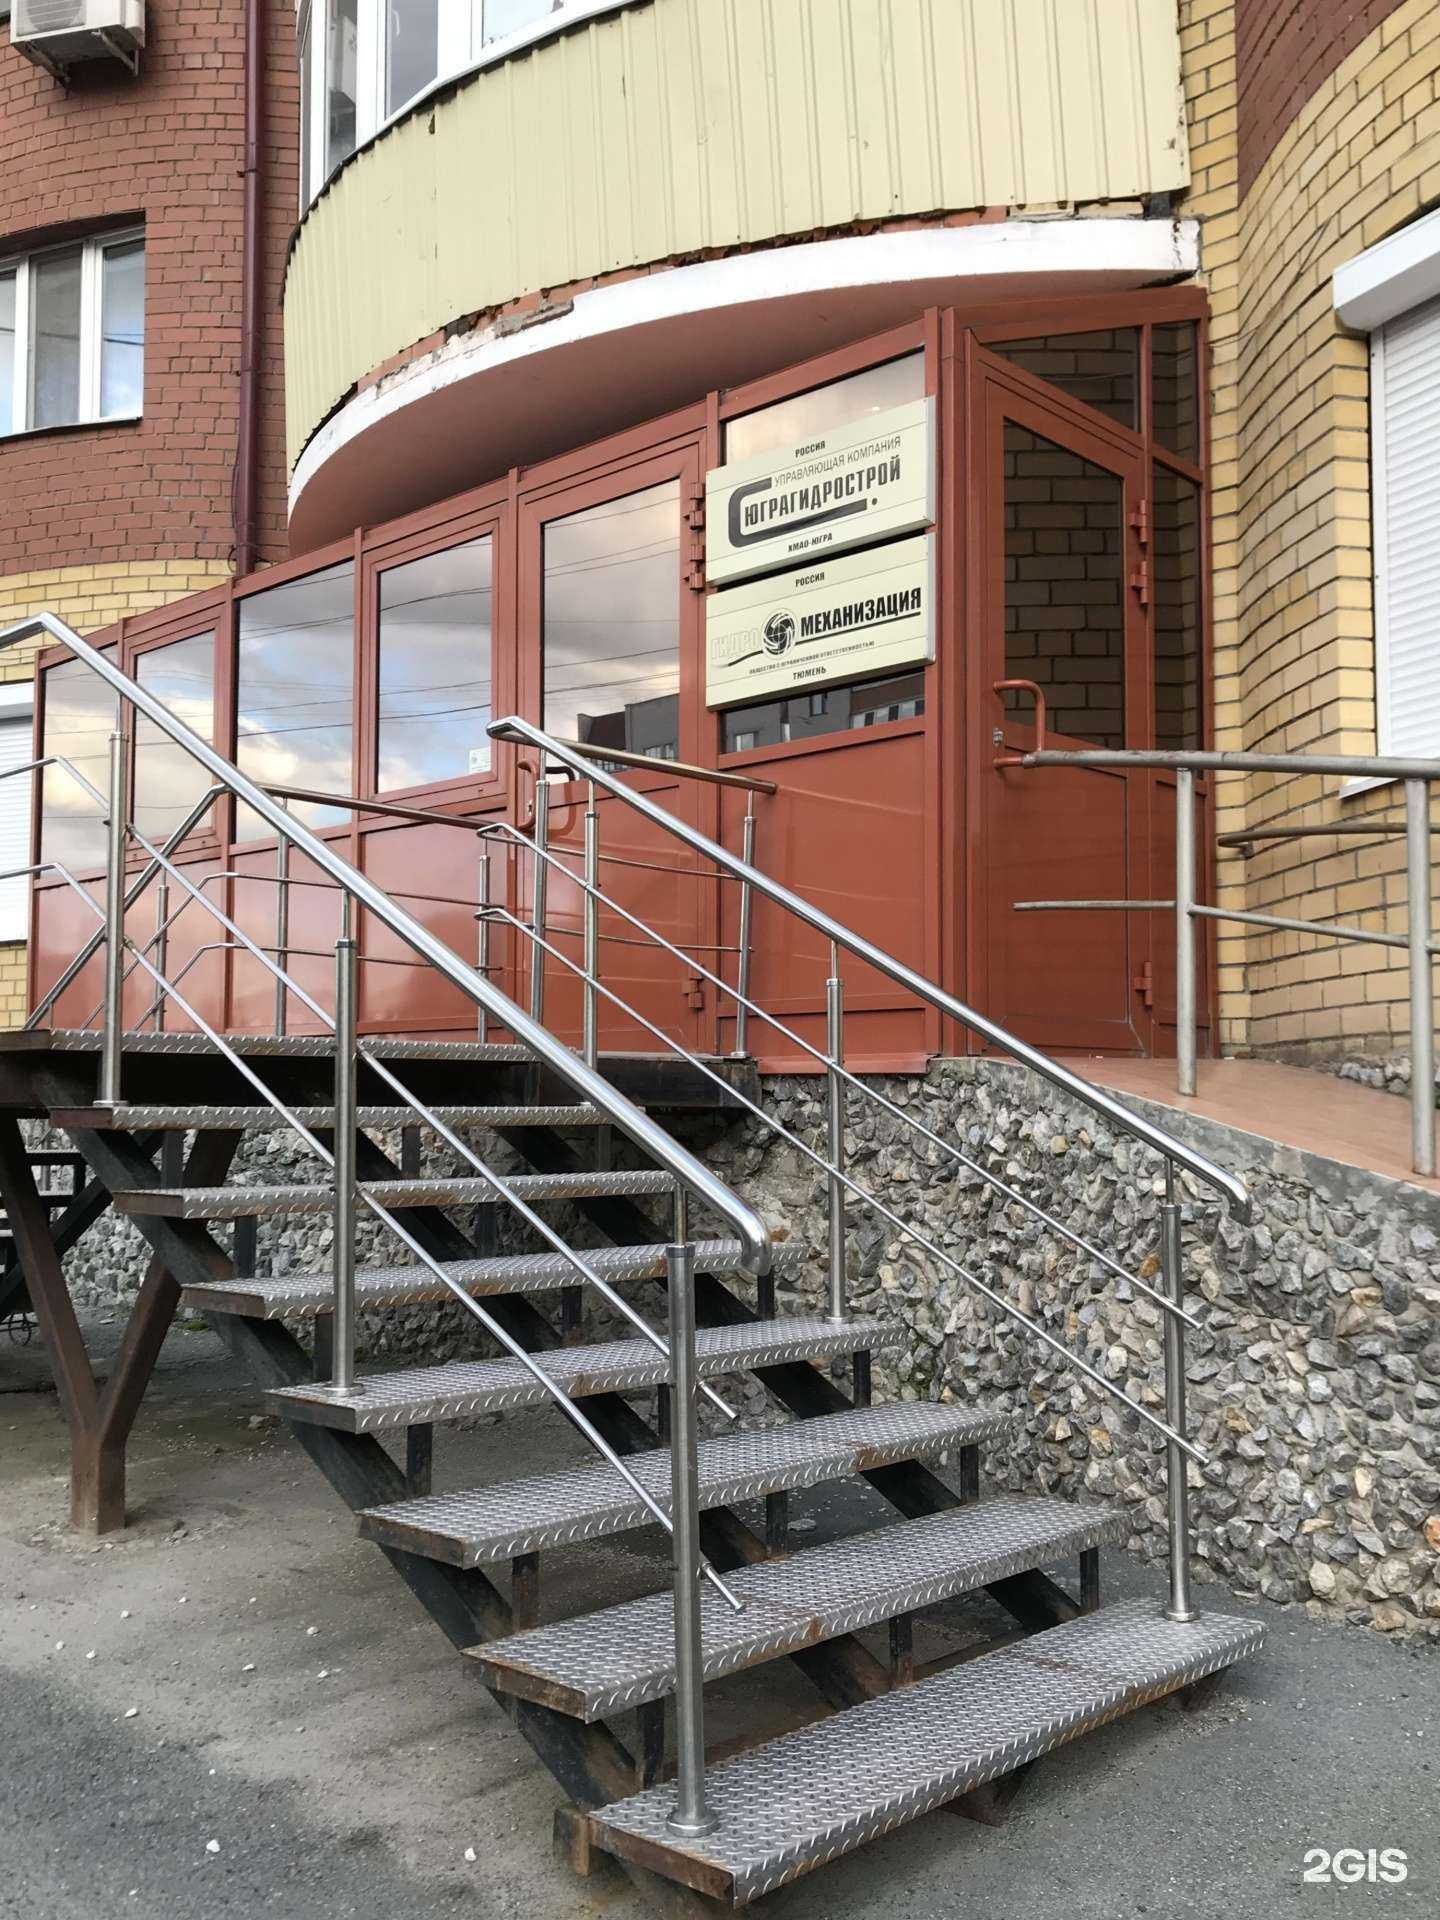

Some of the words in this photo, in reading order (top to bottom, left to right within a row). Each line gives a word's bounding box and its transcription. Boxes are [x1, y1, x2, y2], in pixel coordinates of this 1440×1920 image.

[795, 440, 826, 458] РОССИЯ
[774, 454, 845, 488] УПРАВЛЯЮЩАЯ
[847, 436, 901, 466] КОМПАНИЯ
[744, 454, 901, 527] ЮГРАГИДРОСТРОЙ
[788, 533, 833, 552] ХМАО-ЮГРА
[795, 571, 825, 587] РОССИЯ
[800, 587, 922, 637] МЕХАНИЗАЦИЯ
[793, 666, 827, 680] ТЮМЕНЬ
